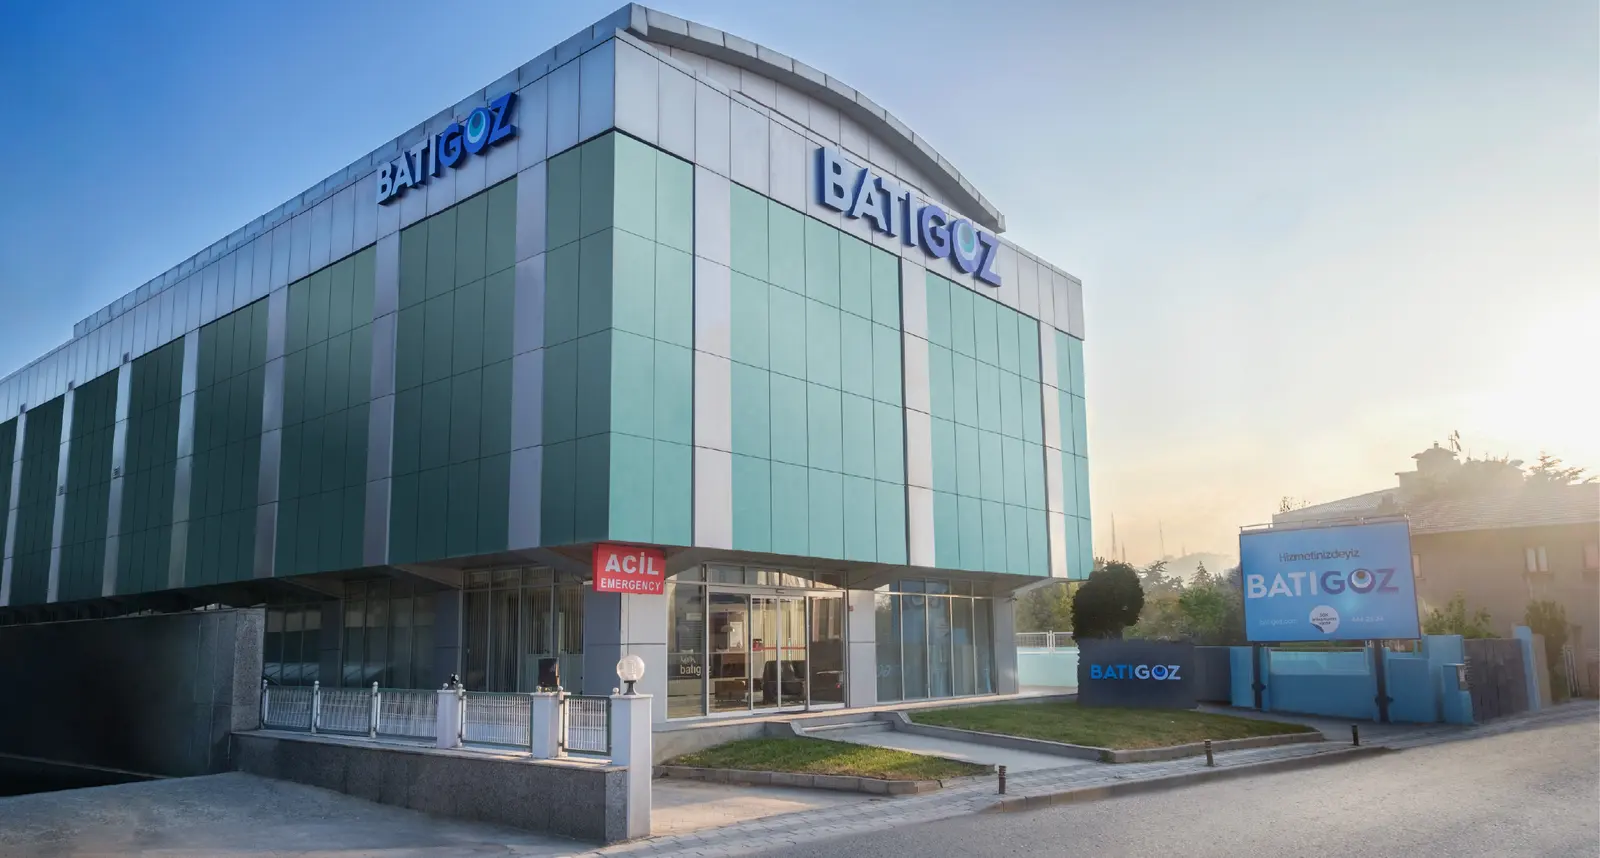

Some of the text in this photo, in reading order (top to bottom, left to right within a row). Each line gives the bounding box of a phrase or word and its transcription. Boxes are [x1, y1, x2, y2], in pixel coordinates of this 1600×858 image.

[376, 92, 518, 205] BATIGOZ
[815, 147, 1002, 287] BATIGOZ
[605, 552, 659, 576] ACİL
[1278, 548, 1361, 563] Hizmetinizdeyiz
[600, 577, 661, 591] EMERGENCY
[1247, 567, 1399, 599] BATIGOZ
[1090, 664, 1181, 681] BATIGOZ
